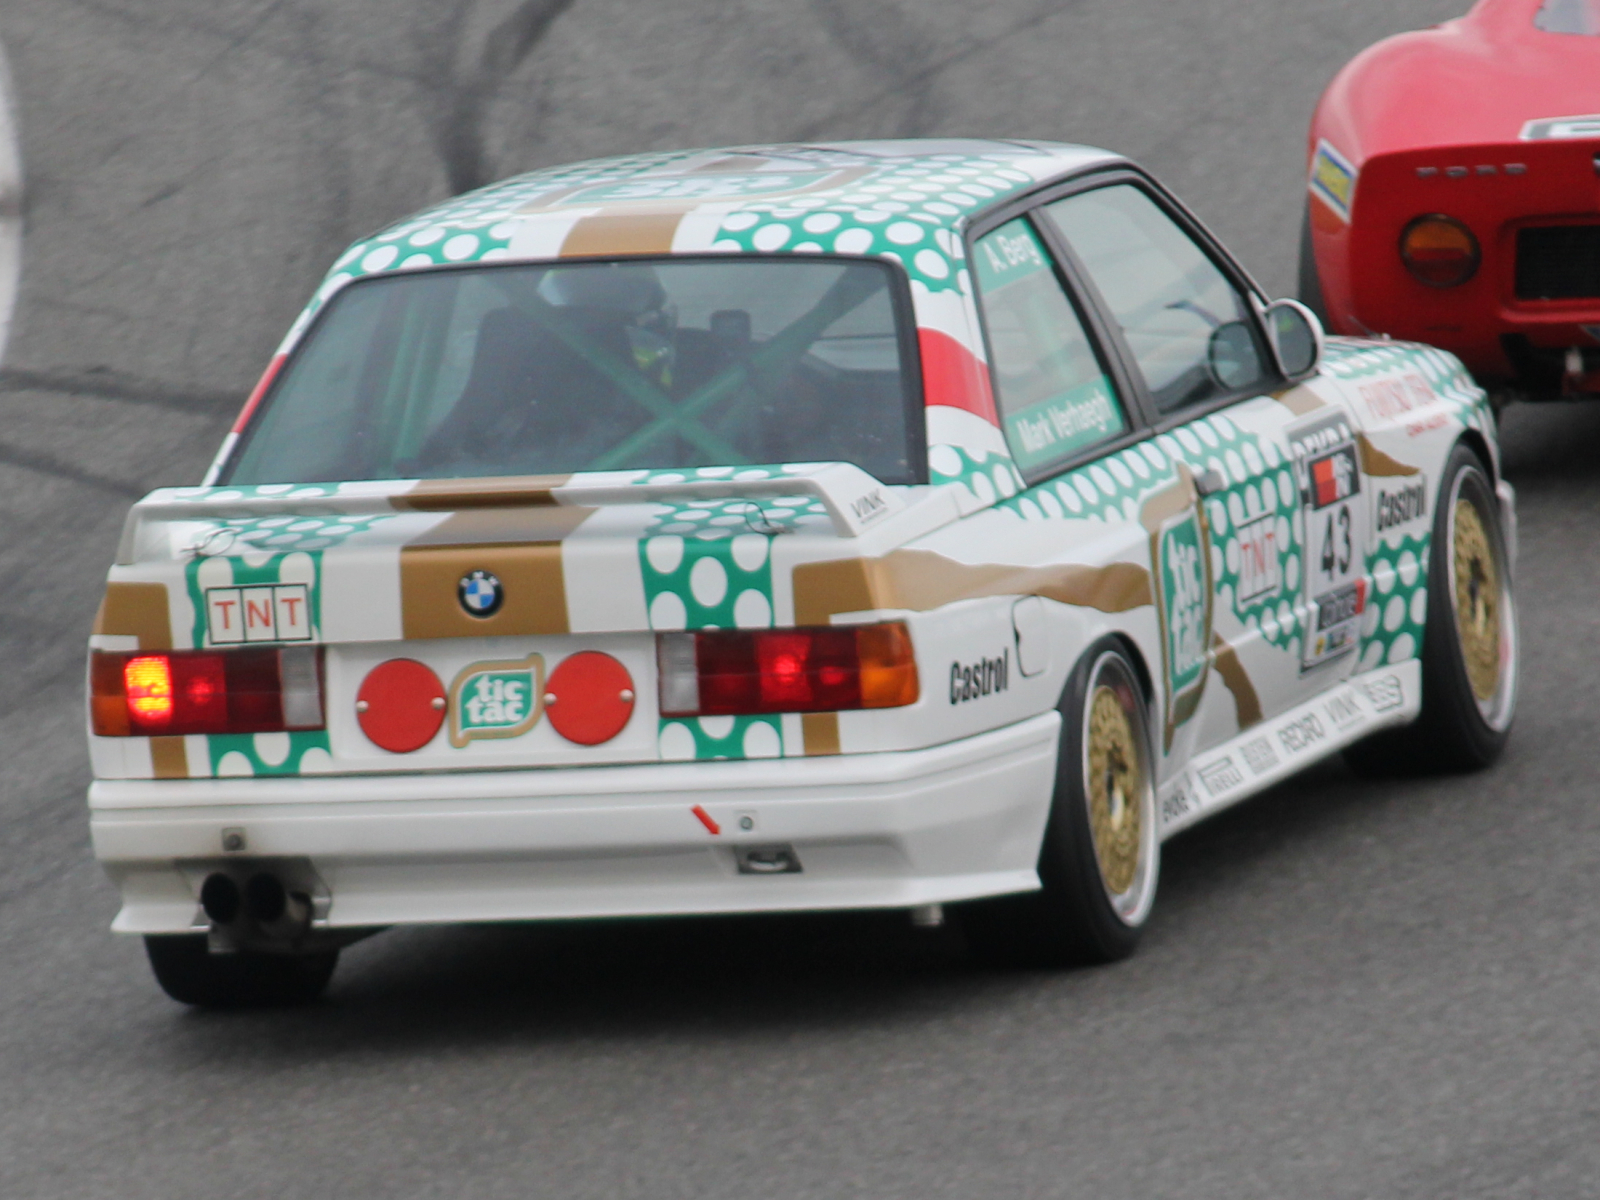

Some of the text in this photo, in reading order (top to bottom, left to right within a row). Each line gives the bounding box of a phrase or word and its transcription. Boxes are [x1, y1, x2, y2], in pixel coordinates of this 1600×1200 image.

[996, 233, 1042, 267] Berg
[1016, 412, 1057, 453] Mark
[850, 488, 887, 518] VINK
[1377, 474, 1427, 532] Castrol
[1241, 532, 1276, 579] TNT
[1321, 503, 1351, 582] 43
[213, 596, 304, 631] TNT
[474, 674, 524, 702] tic
[951, 648, 1009, 705] Castrol
[464, 696, 524, 723] tac
[1276, 711, 1326, 755] RECARO
